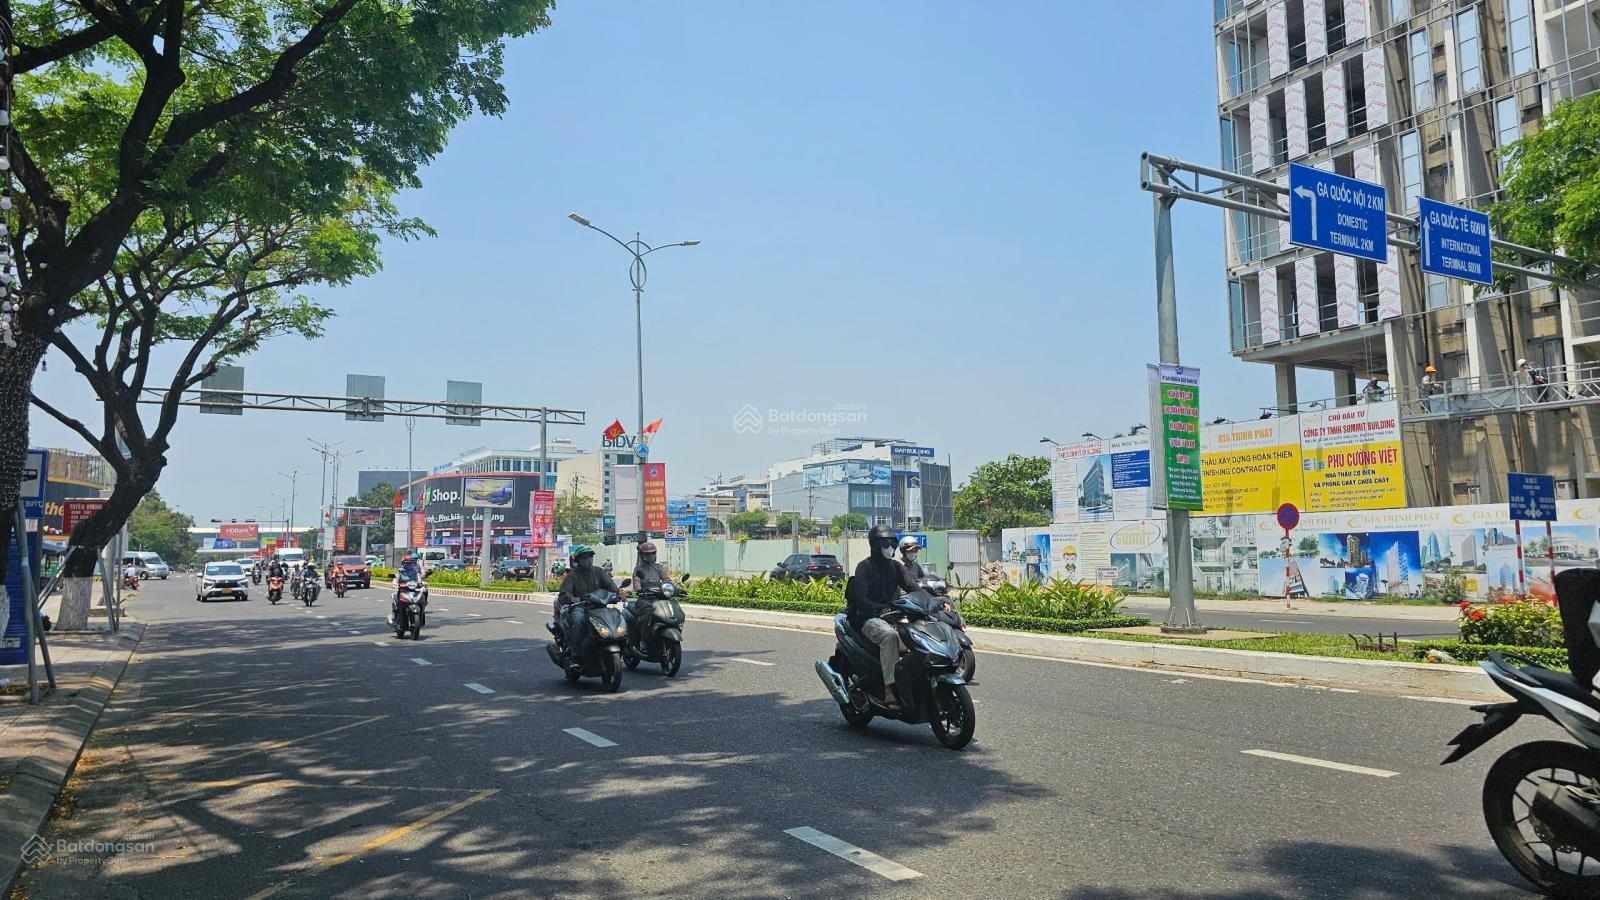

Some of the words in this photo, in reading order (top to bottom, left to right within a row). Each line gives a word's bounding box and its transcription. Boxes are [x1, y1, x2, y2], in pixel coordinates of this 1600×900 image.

[1317, 182, 1328, 198] GA
[1338, 213, 1368, 231] DOMESTIC
[1430, 211, 1440, 226] GA
[1330, 232, 1360, 249] TERMINAL
[1440, 238, 1482, 256] INTERNATIONAL
[1442, 256, 1467, 272] TERMINAL
[1327, 425, 1341, 435] TNHH
[1343, 422, 1366, 433] SUMMIT
[1368, 419, 1395, 430] BUILDING
[1232, 464, 1276, 474] CONTRACTOR
